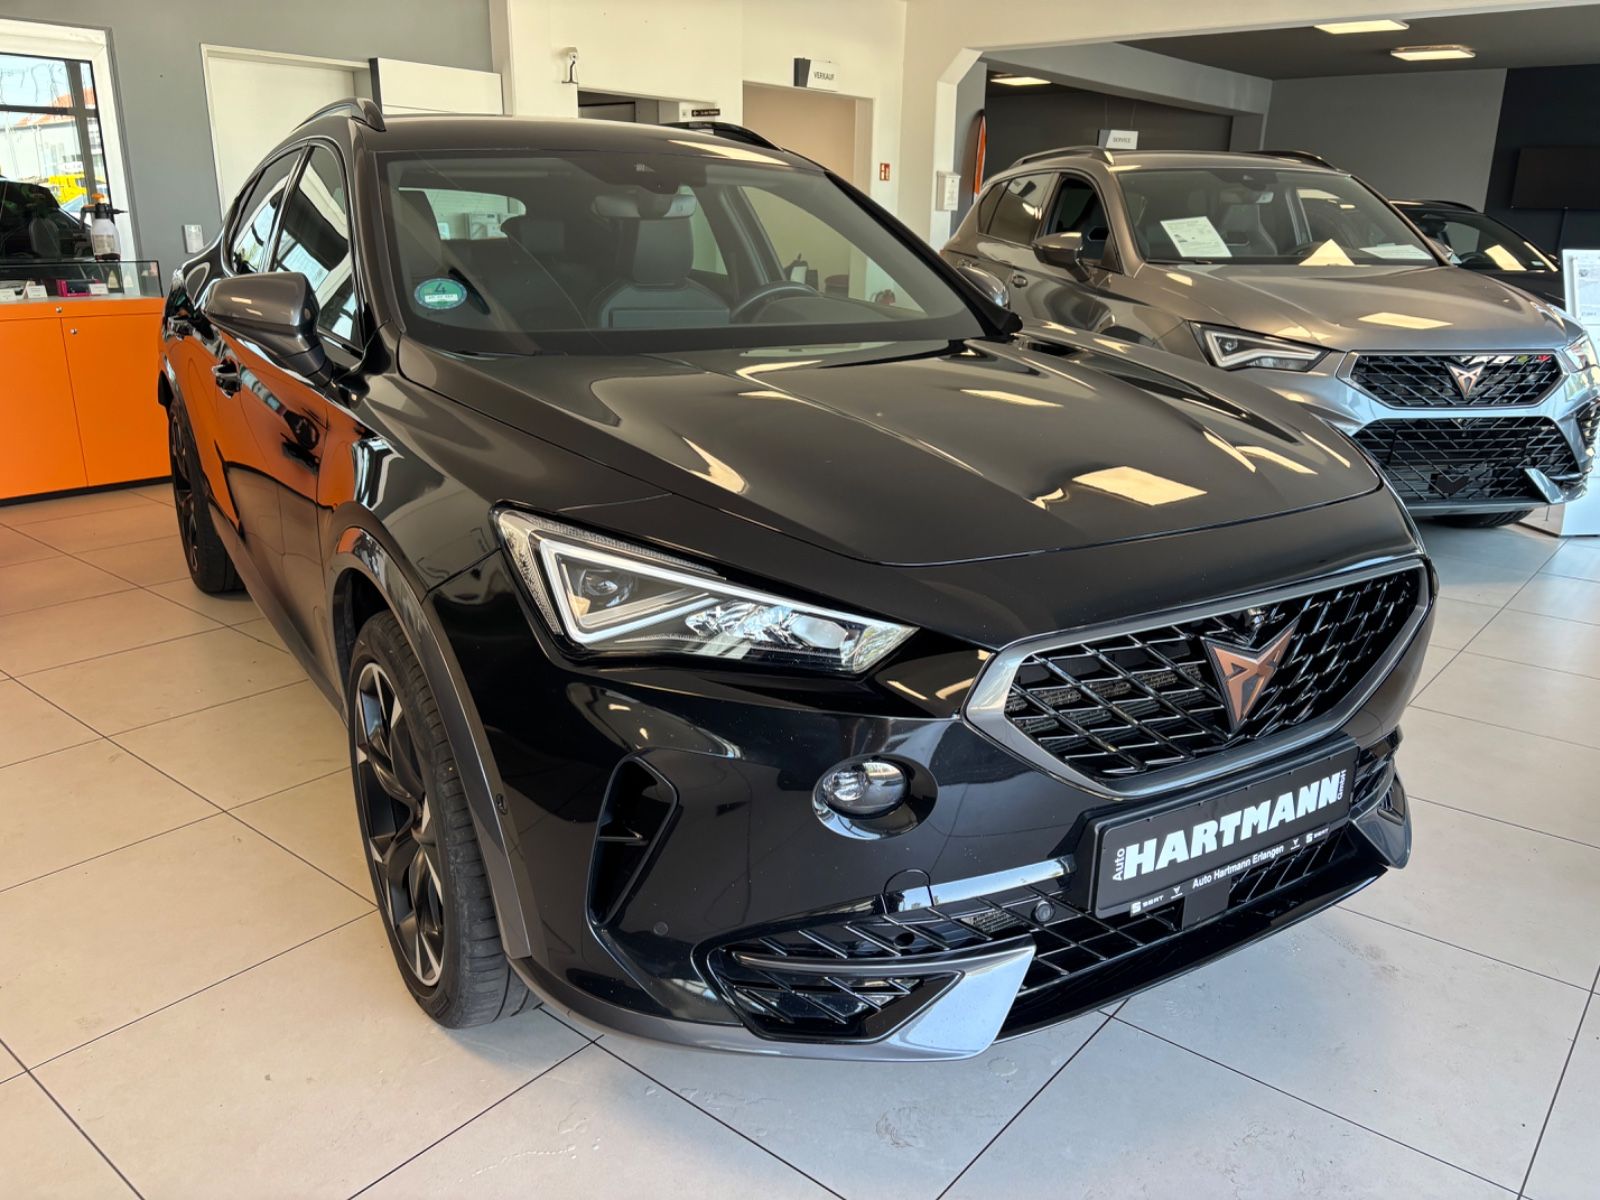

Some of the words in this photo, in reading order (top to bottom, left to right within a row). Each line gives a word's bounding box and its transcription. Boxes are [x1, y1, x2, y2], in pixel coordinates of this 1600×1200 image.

[813, 71, 835, 81] VERKAUF
[434, 282, 447, 294] 4
[1112, 847, 1125, 881] Auto
[1123, 771, 1341, 880] HARTMANN
[1192, 873, 1212, 889] Auto
[1213, 858, 1251, 881] Hartmann
[1252, 845, 1284, 864] Erlangen
